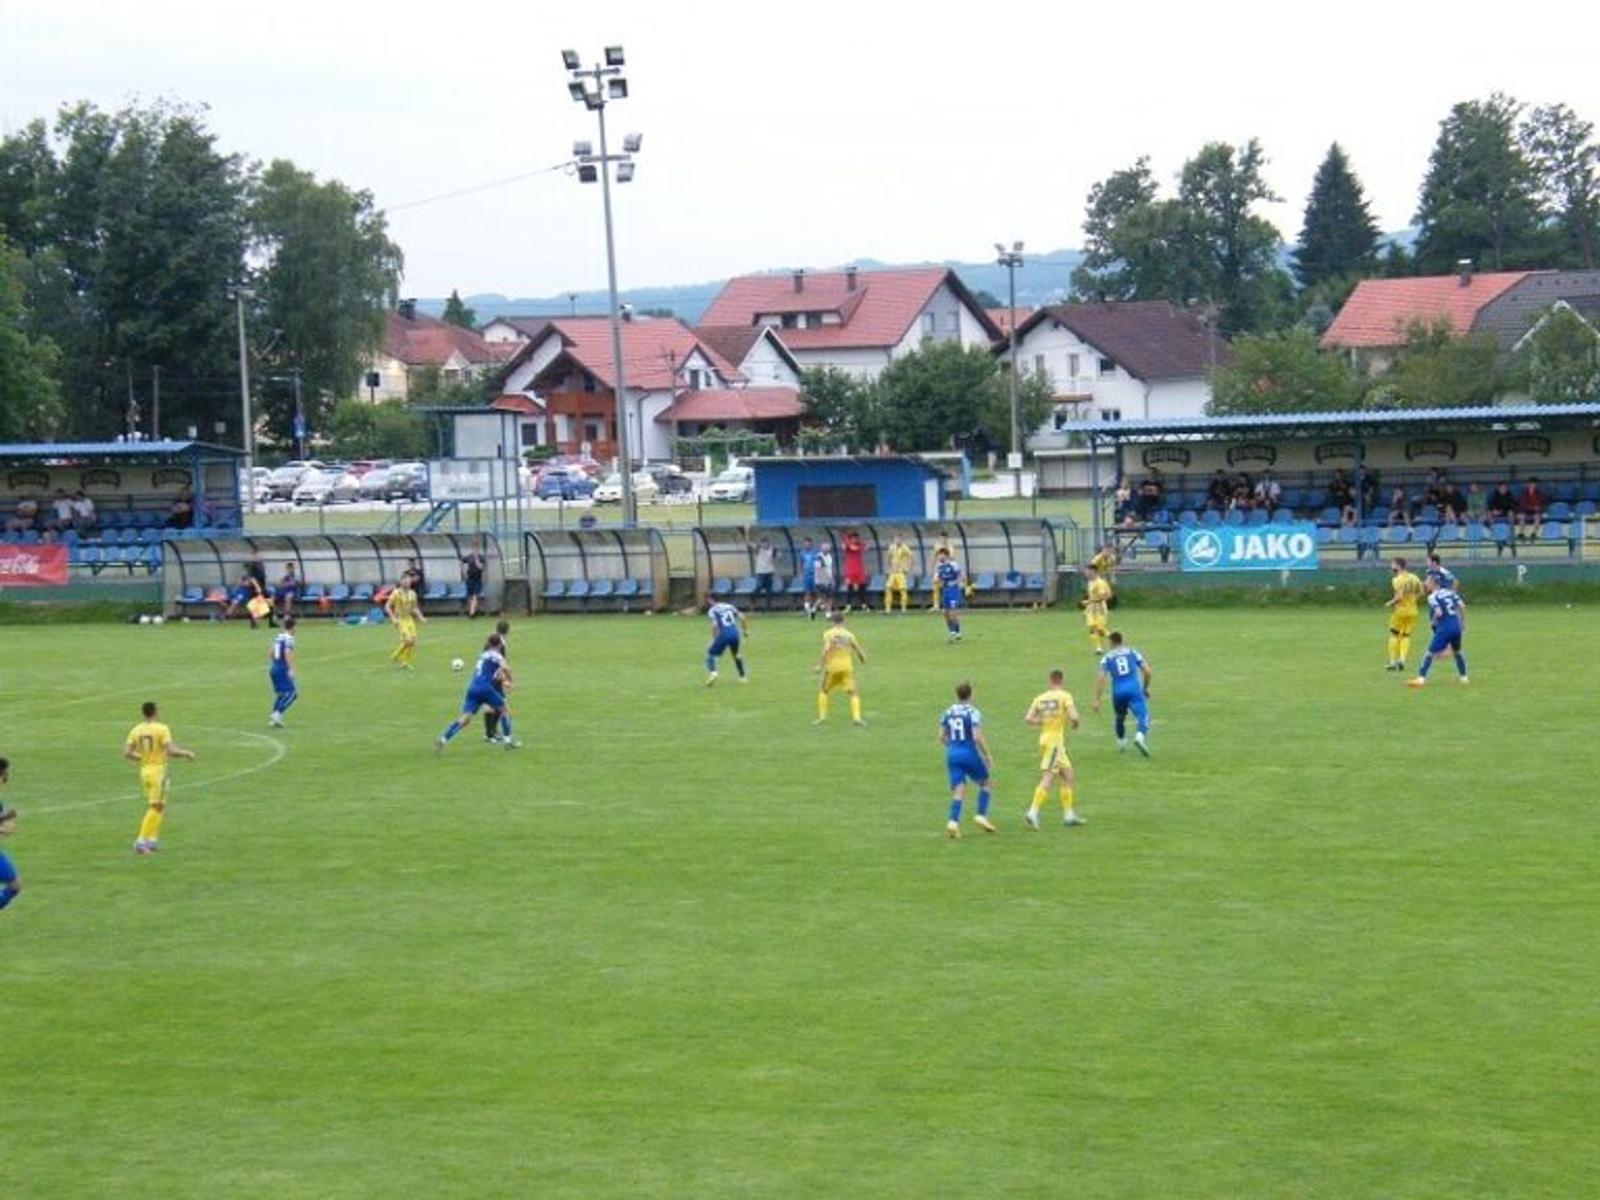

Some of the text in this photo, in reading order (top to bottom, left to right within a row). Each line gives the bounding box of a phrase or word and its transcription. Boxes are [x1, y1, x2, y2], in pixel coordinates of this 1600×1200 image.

[1229, 532, 1314, 560] JAKO
[1116, 655, 1129, 676] 8
[138, 734, 154, 753] 17
